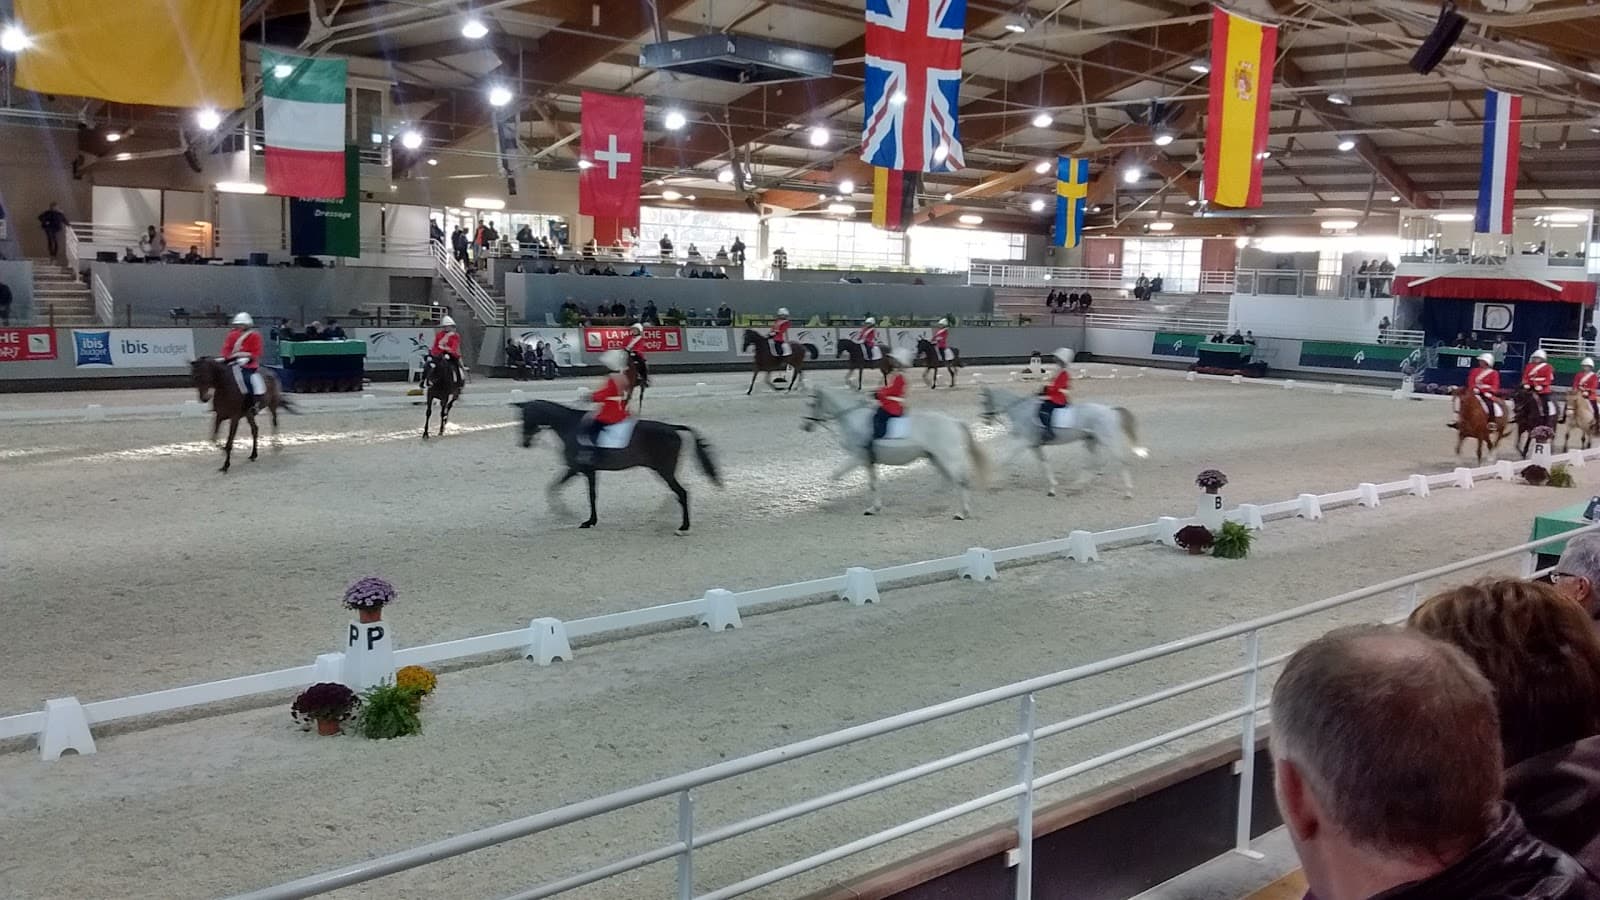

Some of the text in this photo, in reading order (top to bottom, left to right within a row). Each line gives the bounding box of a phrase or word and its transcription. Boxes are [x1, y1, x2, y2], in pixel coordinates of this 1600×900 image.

[314, 209, 352, 219] Dressage
[606, 330, 619, 339] LA
[82, 337, 104, 349] ibis
[121, 340, 149, 354] ibis
[152, 343, 187, 354] budget
[1535, 444, 1544, 454] R
[1215, 496, 1222, 510] B
[349, 623, 359, 647] P
[367, 626, 385, 650] P
